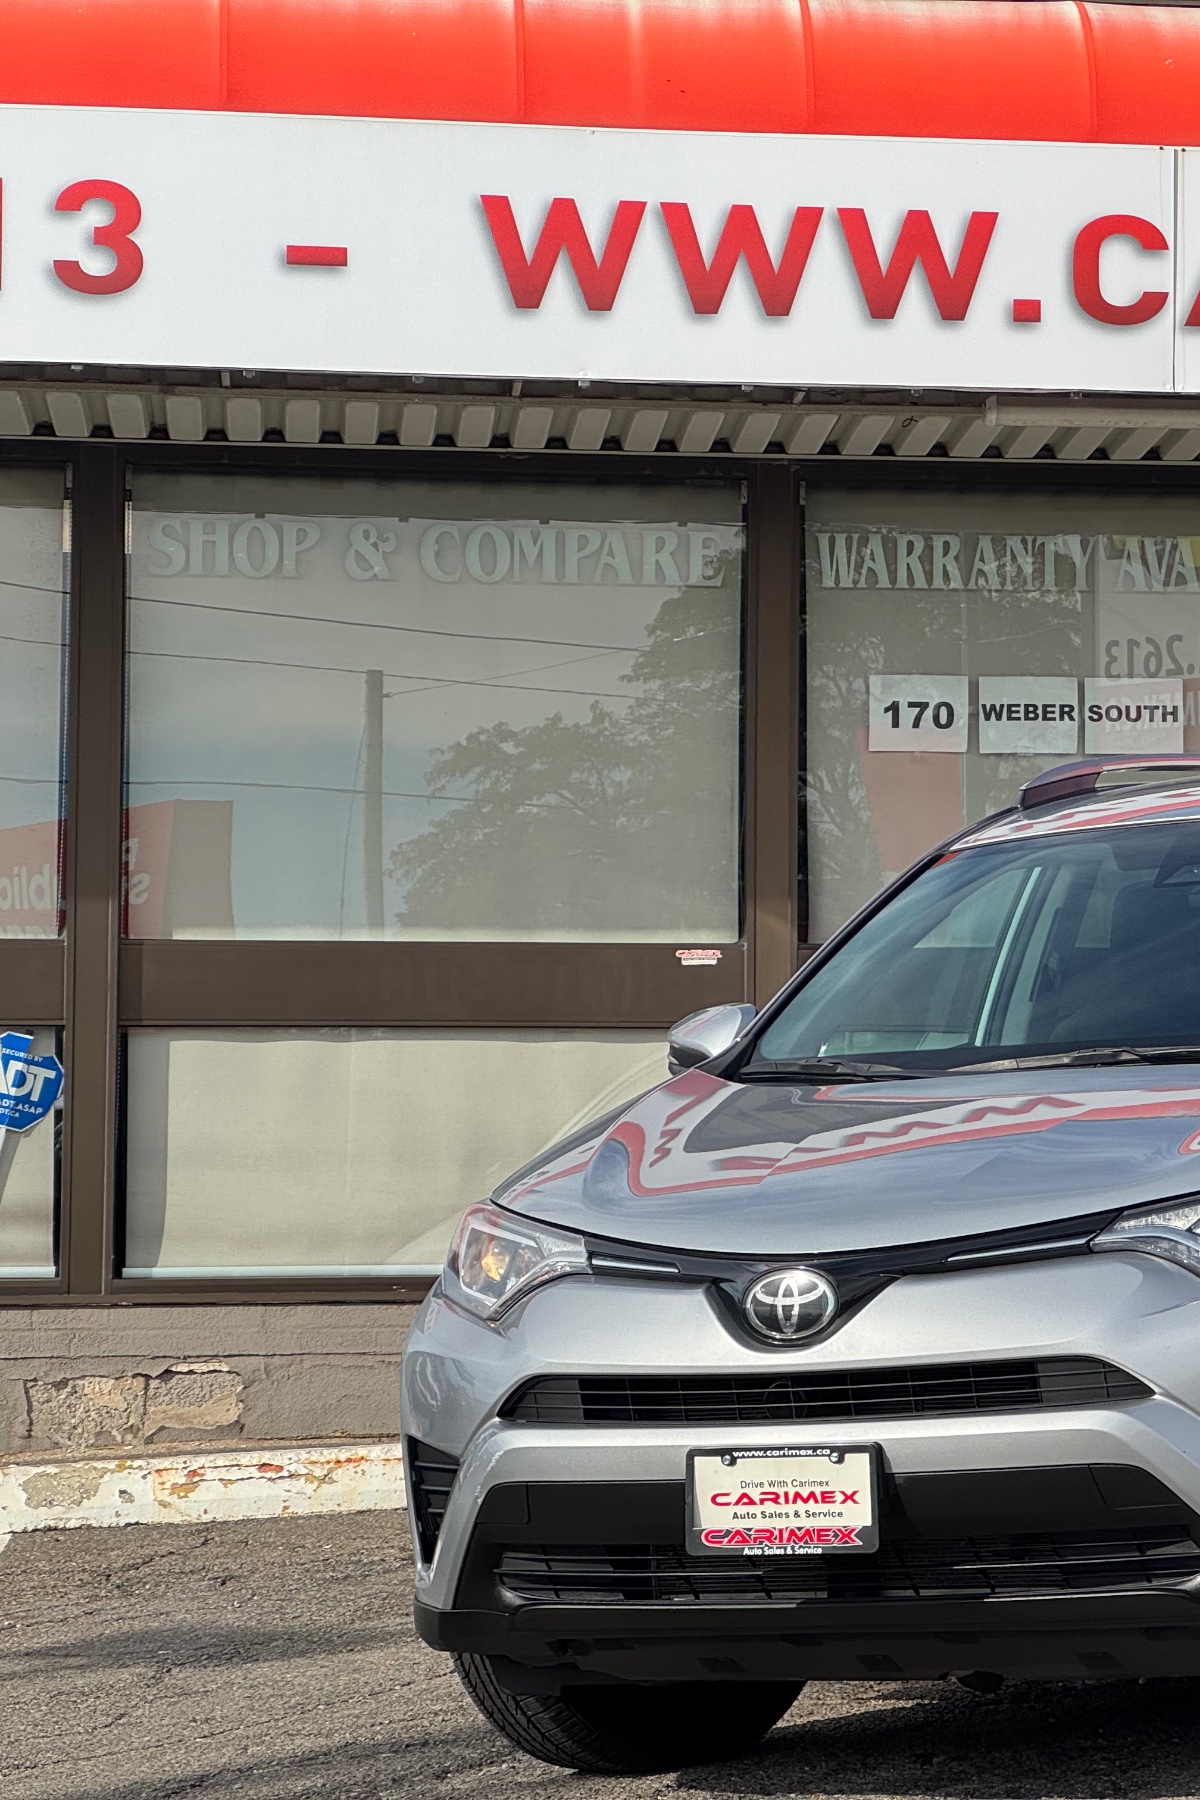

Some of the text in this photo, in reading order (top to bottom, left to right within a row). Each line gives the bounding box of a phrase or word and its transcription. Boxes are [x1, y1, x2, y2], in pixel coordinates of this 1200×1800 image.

[0, 178, 144, 296] 3
[285, 244, 349, 269] -
[148, 514, 726, 588] SHOP & COMPARE
[816, 531, 1096, 592] WARRANTY
[883, 700, 1179, 730] 170 WEBER SOUTH
[1, 1047, 44, 1063] SECURED BY
[0, 1098, 43, 1115] DT.ASAP
[732, 1448, 831, 1458] www.carimex.ca
[740, 1478, 830, 1489] Drive With Carimex
[710, 1490, 860, 1507] CARIMEX
[732, 1509, 844, 1520] Auto Sales & Service
[701, 1526, 863, 1548] CARIMEX
[743, 1546, 823, 1556] Auto Sales & Service
